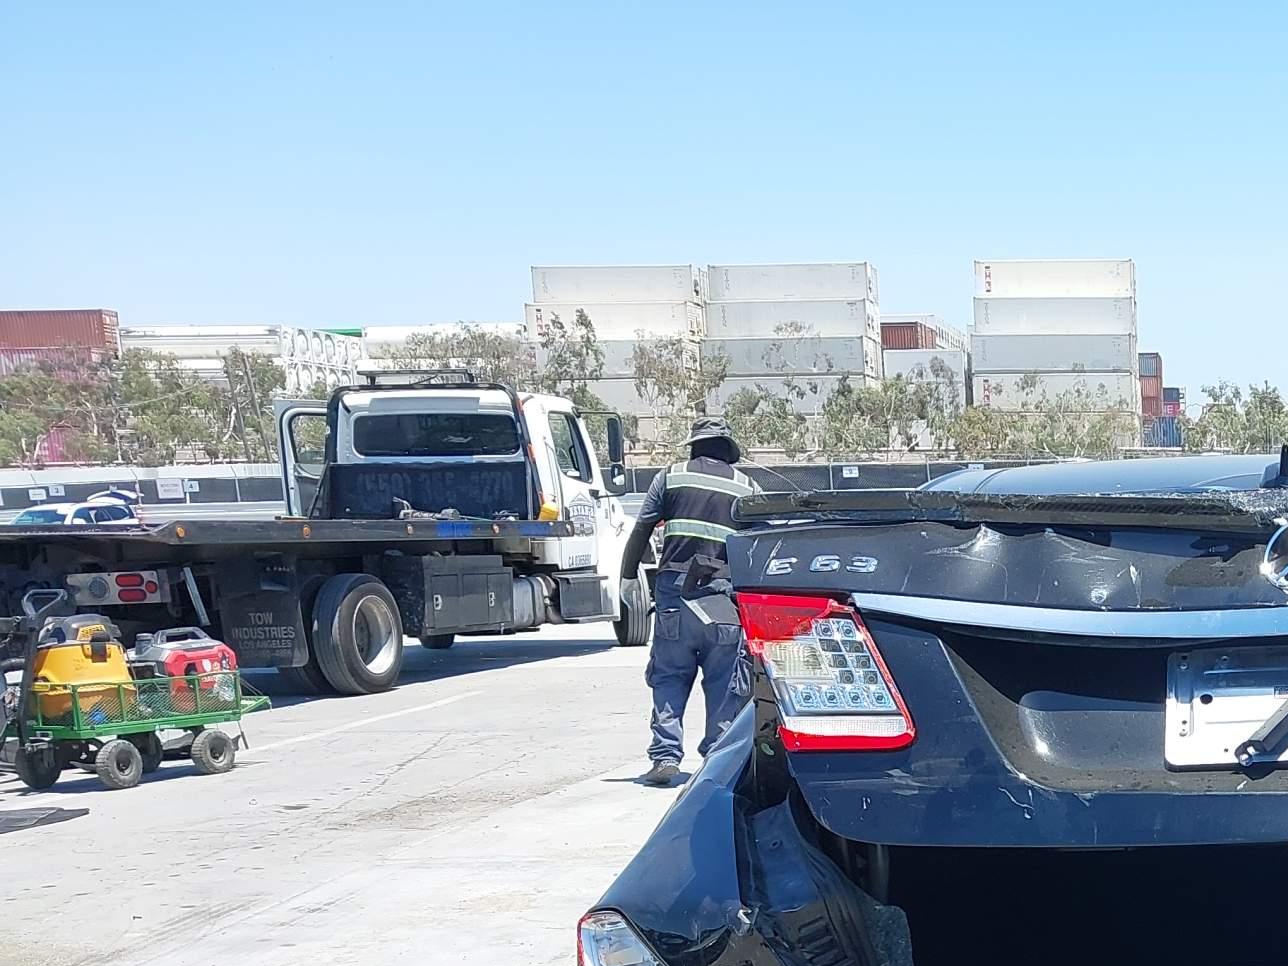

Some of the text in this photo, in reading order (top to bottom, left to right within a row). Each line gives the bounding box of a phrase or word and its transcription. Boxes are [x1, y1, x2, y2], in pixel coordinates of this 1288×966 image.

[766, 555, 878, 576] E 63
[248, 611, 273, 625] TOW
[232, 626, 296, 639] INDUSTRIES
[240, 639, 292, 649] LOS ANGELES
